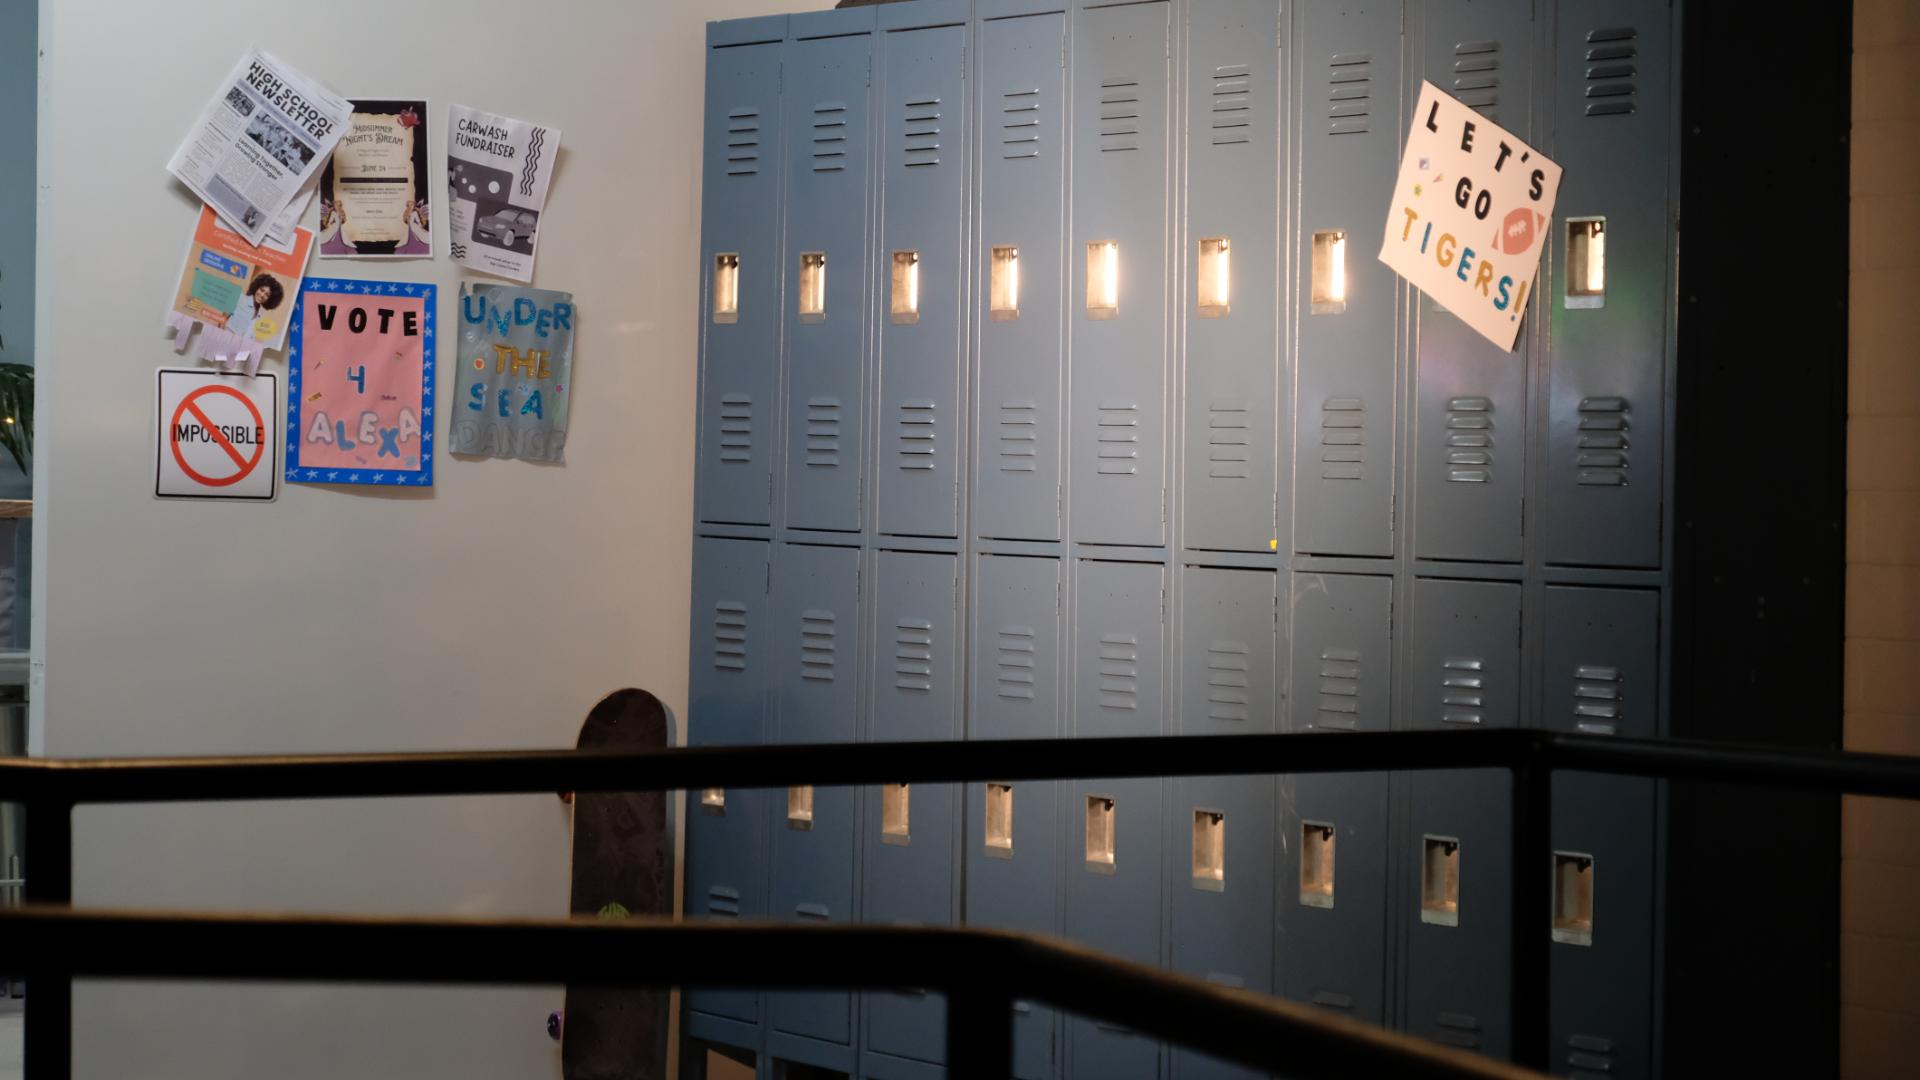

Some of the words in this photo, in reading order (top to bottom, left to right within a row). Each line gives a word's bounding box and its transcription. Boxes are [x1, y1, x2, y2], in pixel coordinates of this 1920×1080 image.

[246, 73, 326, 140] NEWSLETTER
[249, 61, 283, 92] HIGH
[282, 88, 334, 135] SCHOOL
[455, 132, 515, 159] FUNDRAISER
[458, 118, 508, 141] CARWASH
[1426, 100, 1545, 201] LET'S
[1455, 177, 1492, 220] GO
[1402, 207, 1527, 321] TIGERS!
[317, 304, 418, 337] VOTE
[463, 295, 573, 338] UNDER
[346, 365, 365, 394] 4
[492, 344, 553, 380] THE
[468, 382, 544, 421] SEA
[306, 406, 422, 459] ALEXA
